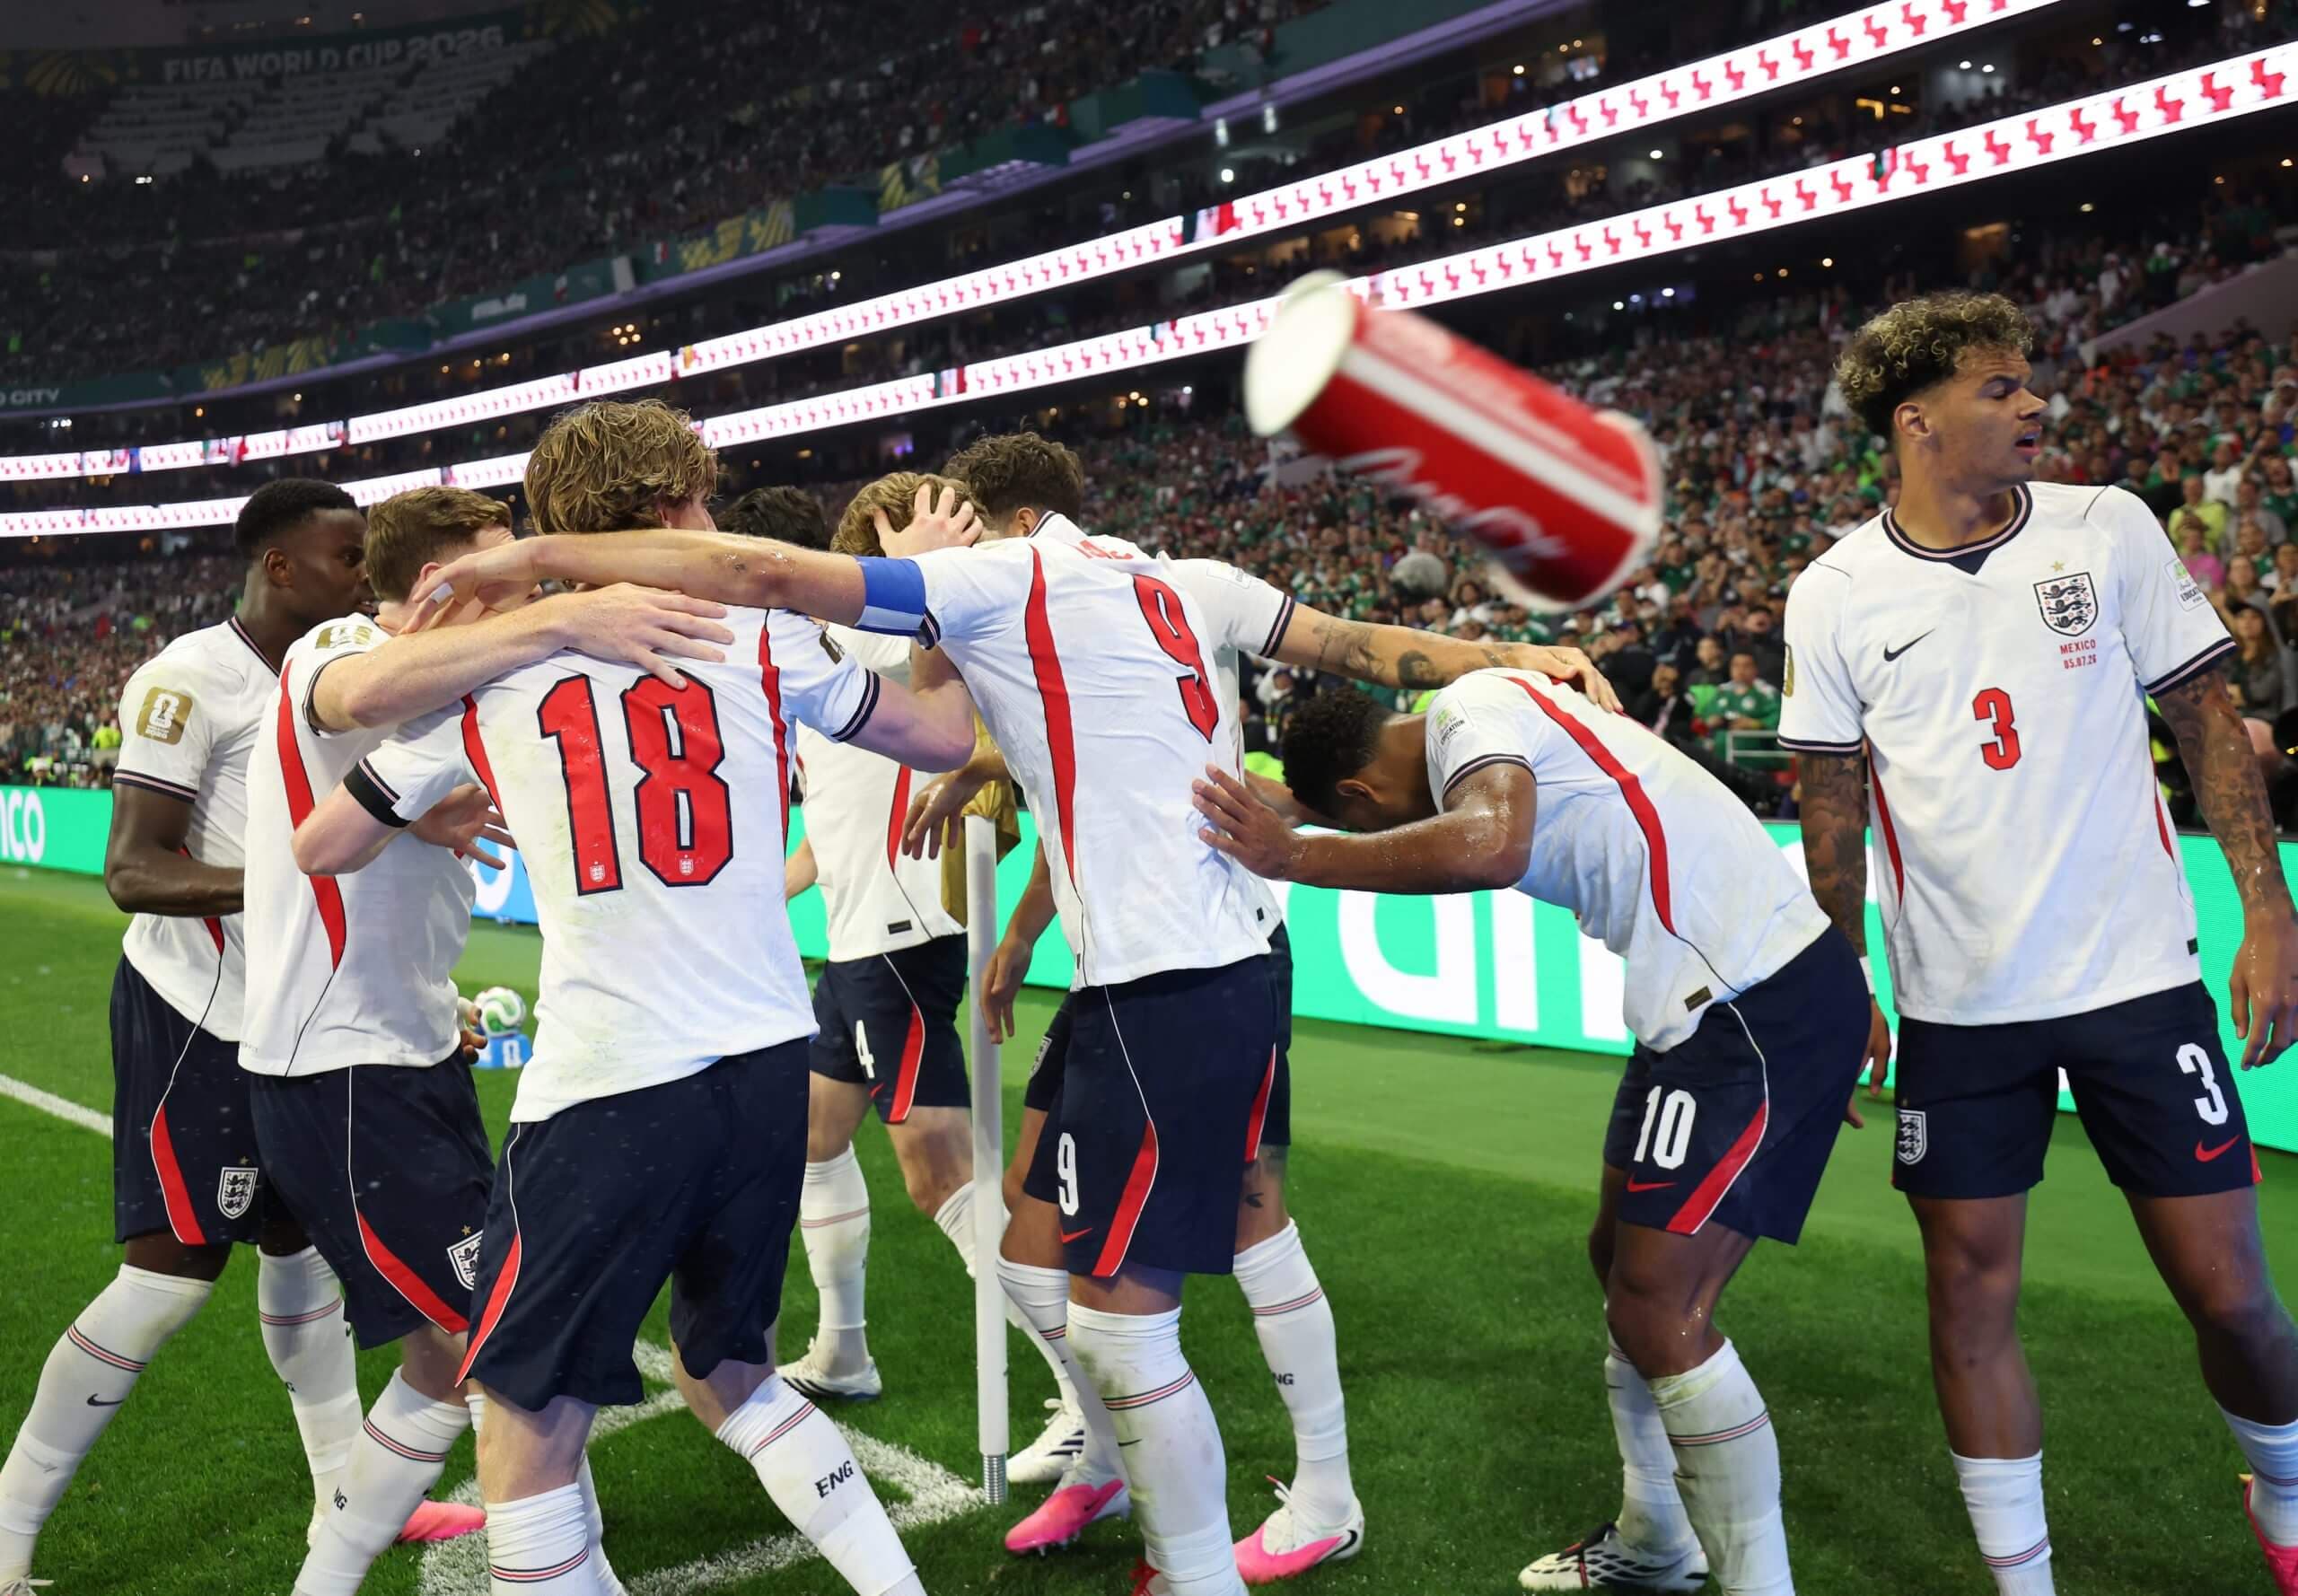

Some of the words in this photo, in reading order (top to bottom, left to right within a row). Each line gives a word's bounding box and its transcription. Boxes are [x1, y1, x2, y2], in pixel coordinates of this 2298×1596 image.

[163, 56, 228, 83] FIFA
[232, 48, 340, 81] WORLD
[346, 39, 401, 68] CUP
[406, 24, 505, 61] 2026
[1134, 574, 1220, 744] 9
[2060, 639, 2096, 654] MEXICO
[1972, 687, 2022, 771] 3
[537, 668, 734, 896] 18
[0, 789, 46, 864] co
[855, 1019, 875, 1079] 4
[2175, 1042, 2229, 1126] 3
[1633, 1085, 1697, 1171] 10
[1057, 1132, 1080, 1216] 9
[1271, 1372, 1294, 1386] NG
[333, 1486, 348, 1512] NG
[814, 1460, 855, 1499] ENG
